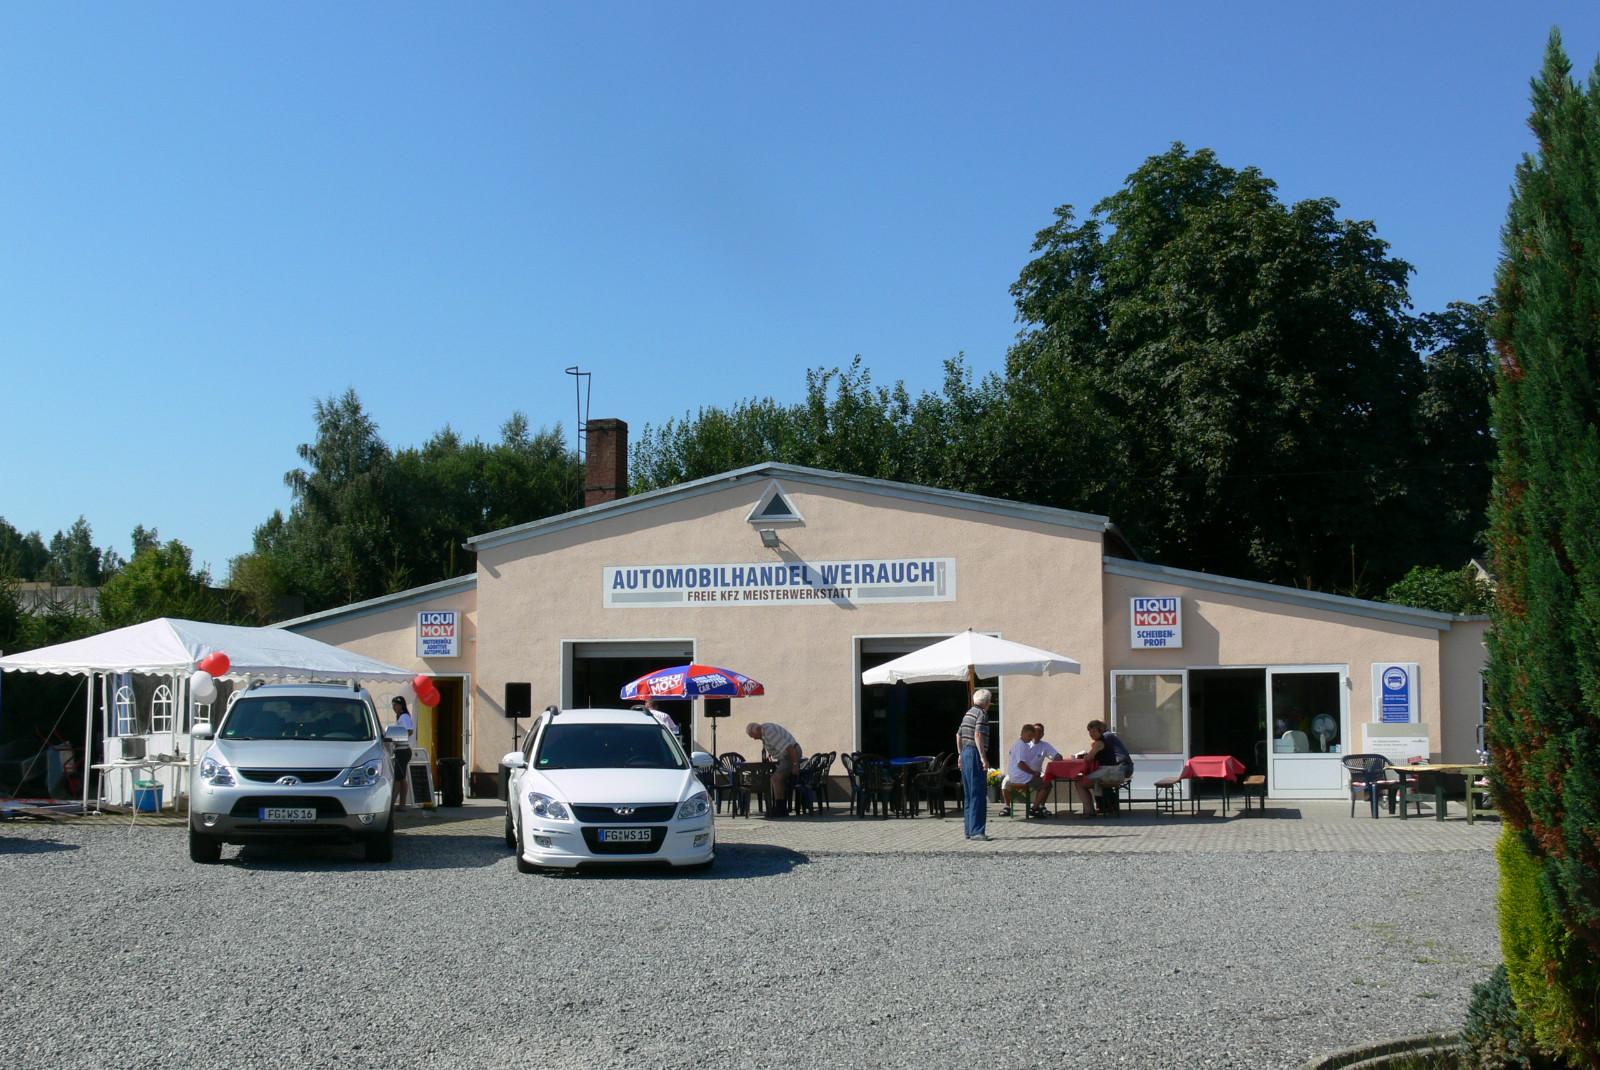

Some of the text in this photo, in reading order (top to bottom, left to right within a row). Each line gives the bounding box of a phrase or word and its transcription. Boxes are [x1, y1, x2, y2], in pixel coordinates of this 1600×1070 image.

[612, 561, 935, 590] AUTOMOBILHANDEL WEIRAUCH
[687, 587, 853, 602] FREIE KFZ MEISTERWERKSTATT
[1135, 599, 1175, 612] LIQUI
[421, 613, 453, 625] LIQUI
[1135, 612, 1176, 625] MOLY
[421, 625, 453, 637] MOLY
[1136, 630, 1176, 638] SCHEIBEN-
[650, 678, 682, 696] MOLY
